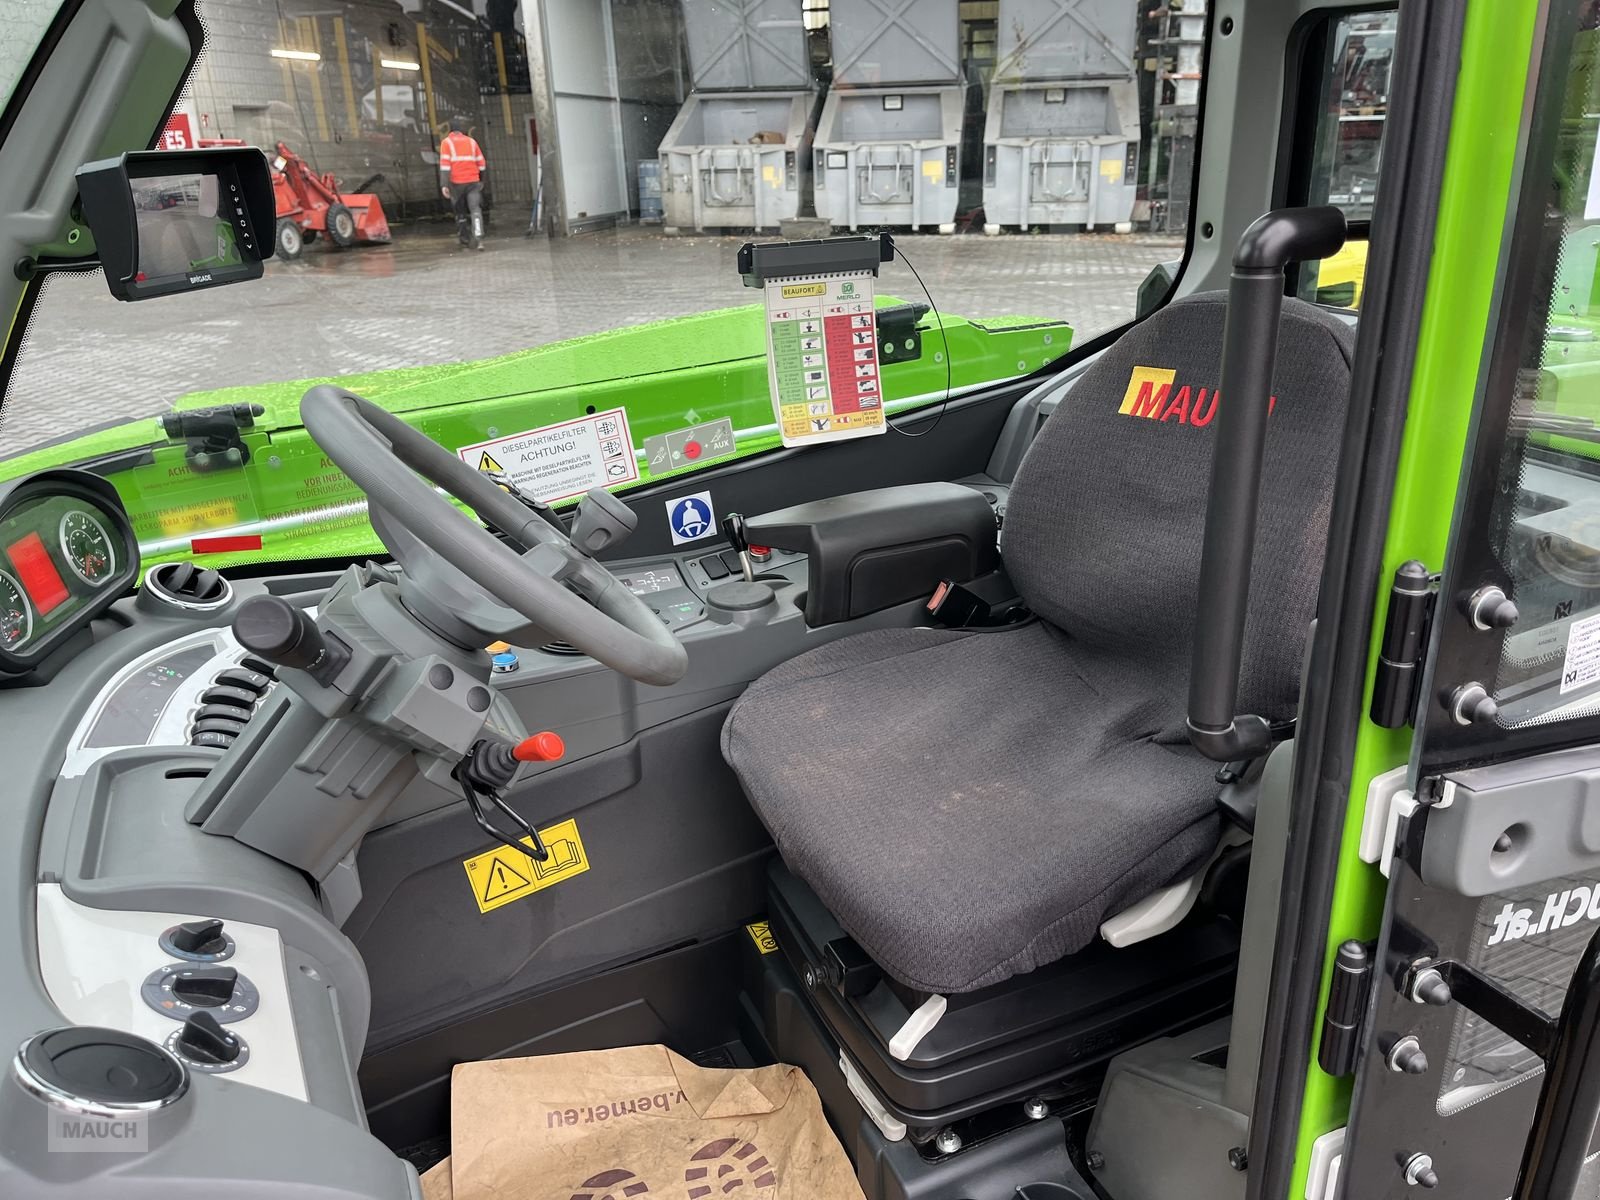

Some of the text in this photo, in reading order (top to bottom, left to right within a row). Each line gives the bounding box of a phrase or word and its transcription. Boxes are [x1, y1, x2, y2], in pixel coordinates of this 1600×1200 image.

[190, 274, 213, 284] BRIGADE
[783, 286, 815, 296] BEAUFORT
[1130, 381, 1277, 428] MAU
[502, 426, 587, 454] DIESELPARTIKELFILTER
[713, 439, 730, 450] AUX
[520, 441, 577, 463] ACHTUNG!
[511, 454, 591, 479] MASCHINE MIT DIESELPARTIKELFILTER
[536, 466, 570, 480] REGENERATION
[569, 460, 592, 471] BEACHTEN
[304, 476, 321, 487] VOR
[187, 493, 248, 511] AUSGEFAHRENEM
[265, 511, 283, 521] VOR
[284, 509, 301, 519] DER
[301, 504, 328, 516] FAHRT
[328, 501, 346, 511] AUF
[202, 506, 238, 520] VERBOTEN
